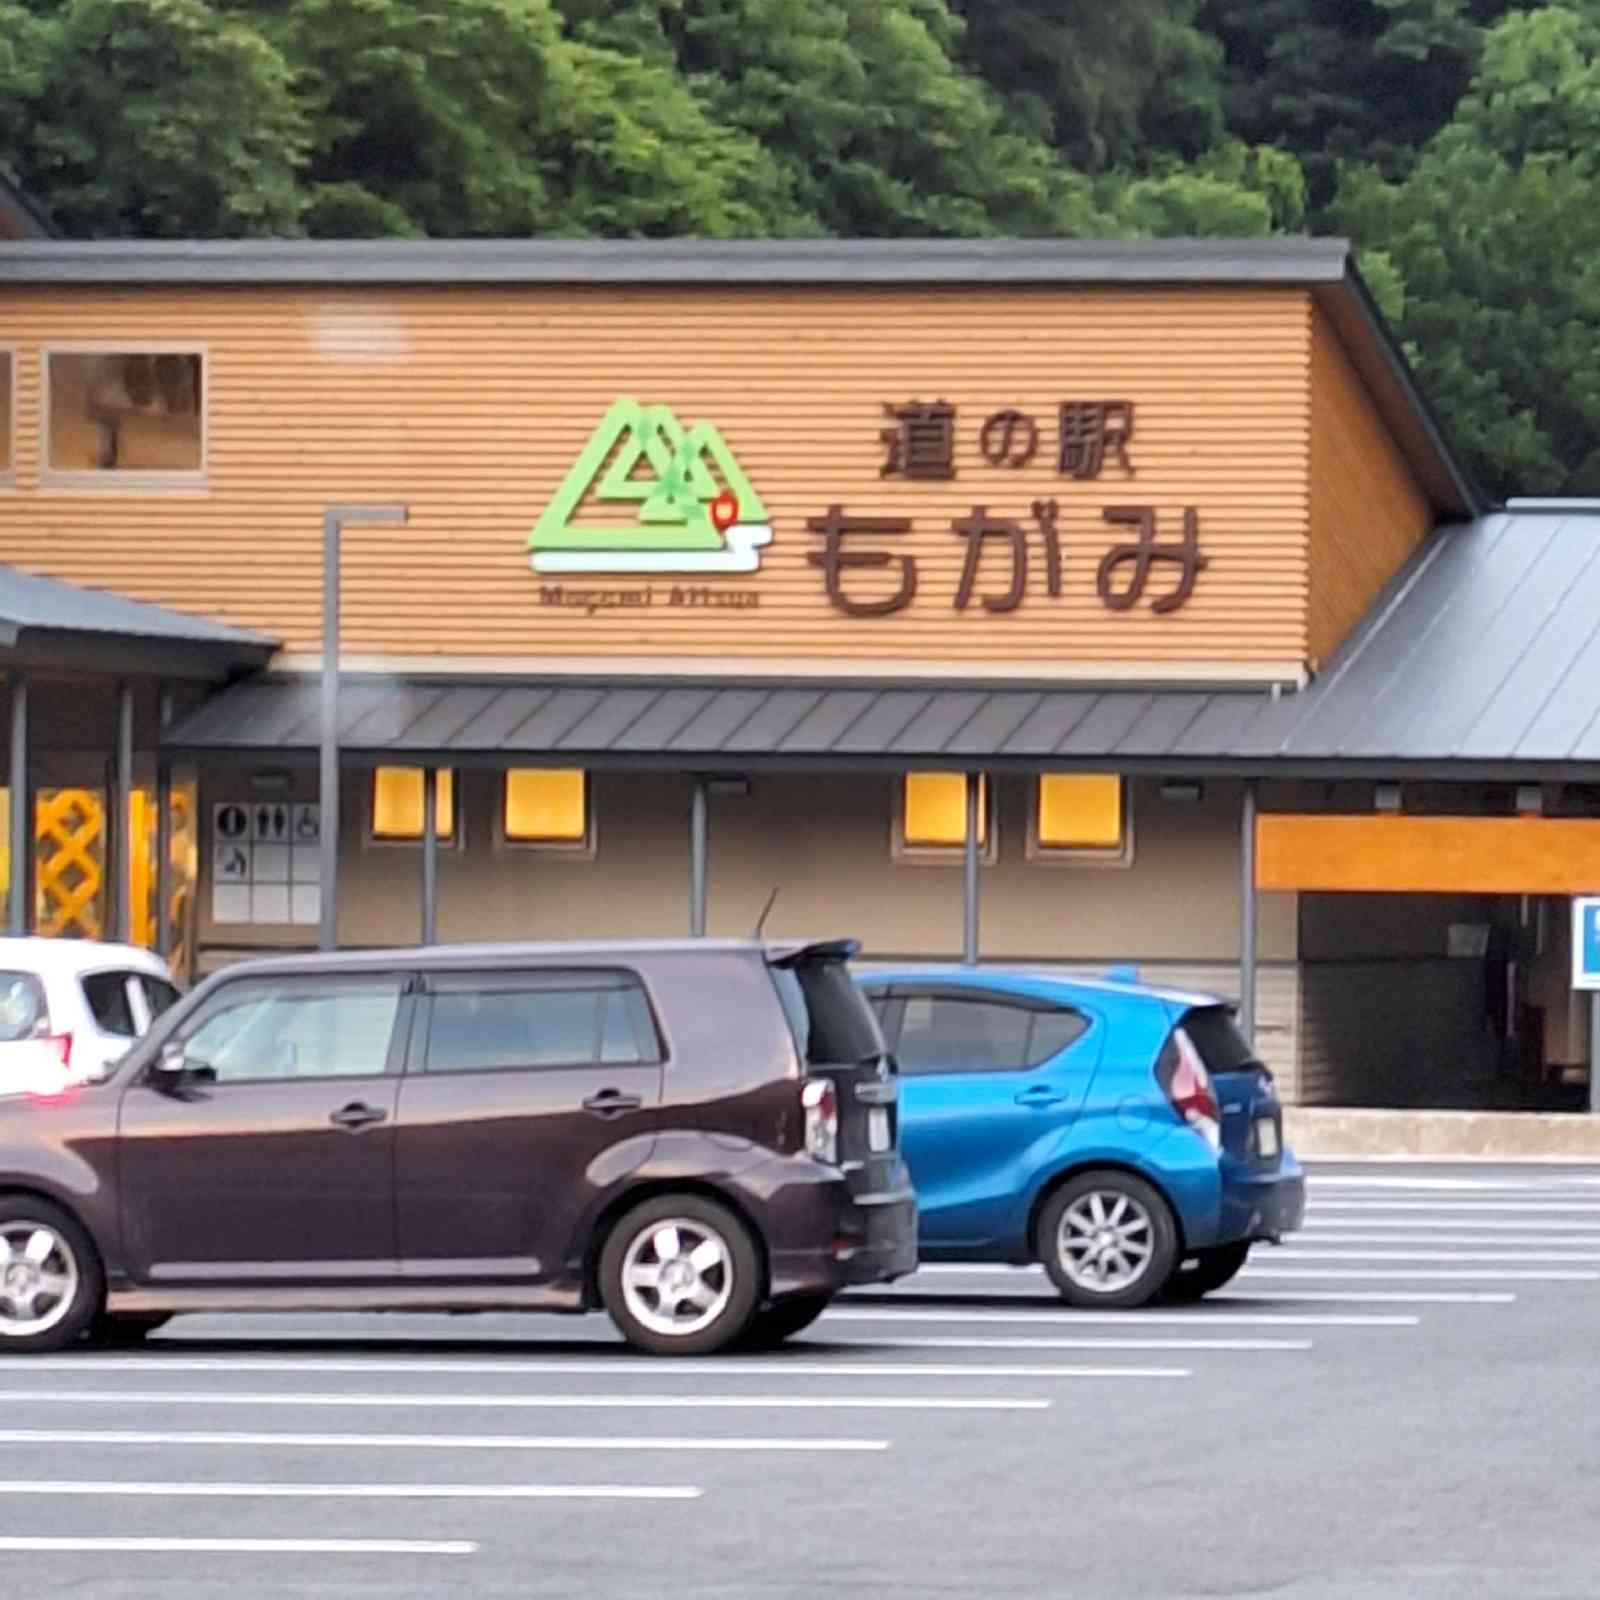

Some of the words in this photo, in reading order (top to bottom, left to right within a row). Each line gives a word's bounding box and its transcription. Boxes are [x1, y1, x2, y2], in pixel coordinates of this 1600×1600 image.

[879, 399, 1136, 481] 道の駅
[806, 500, 1209, 618] もがみ
